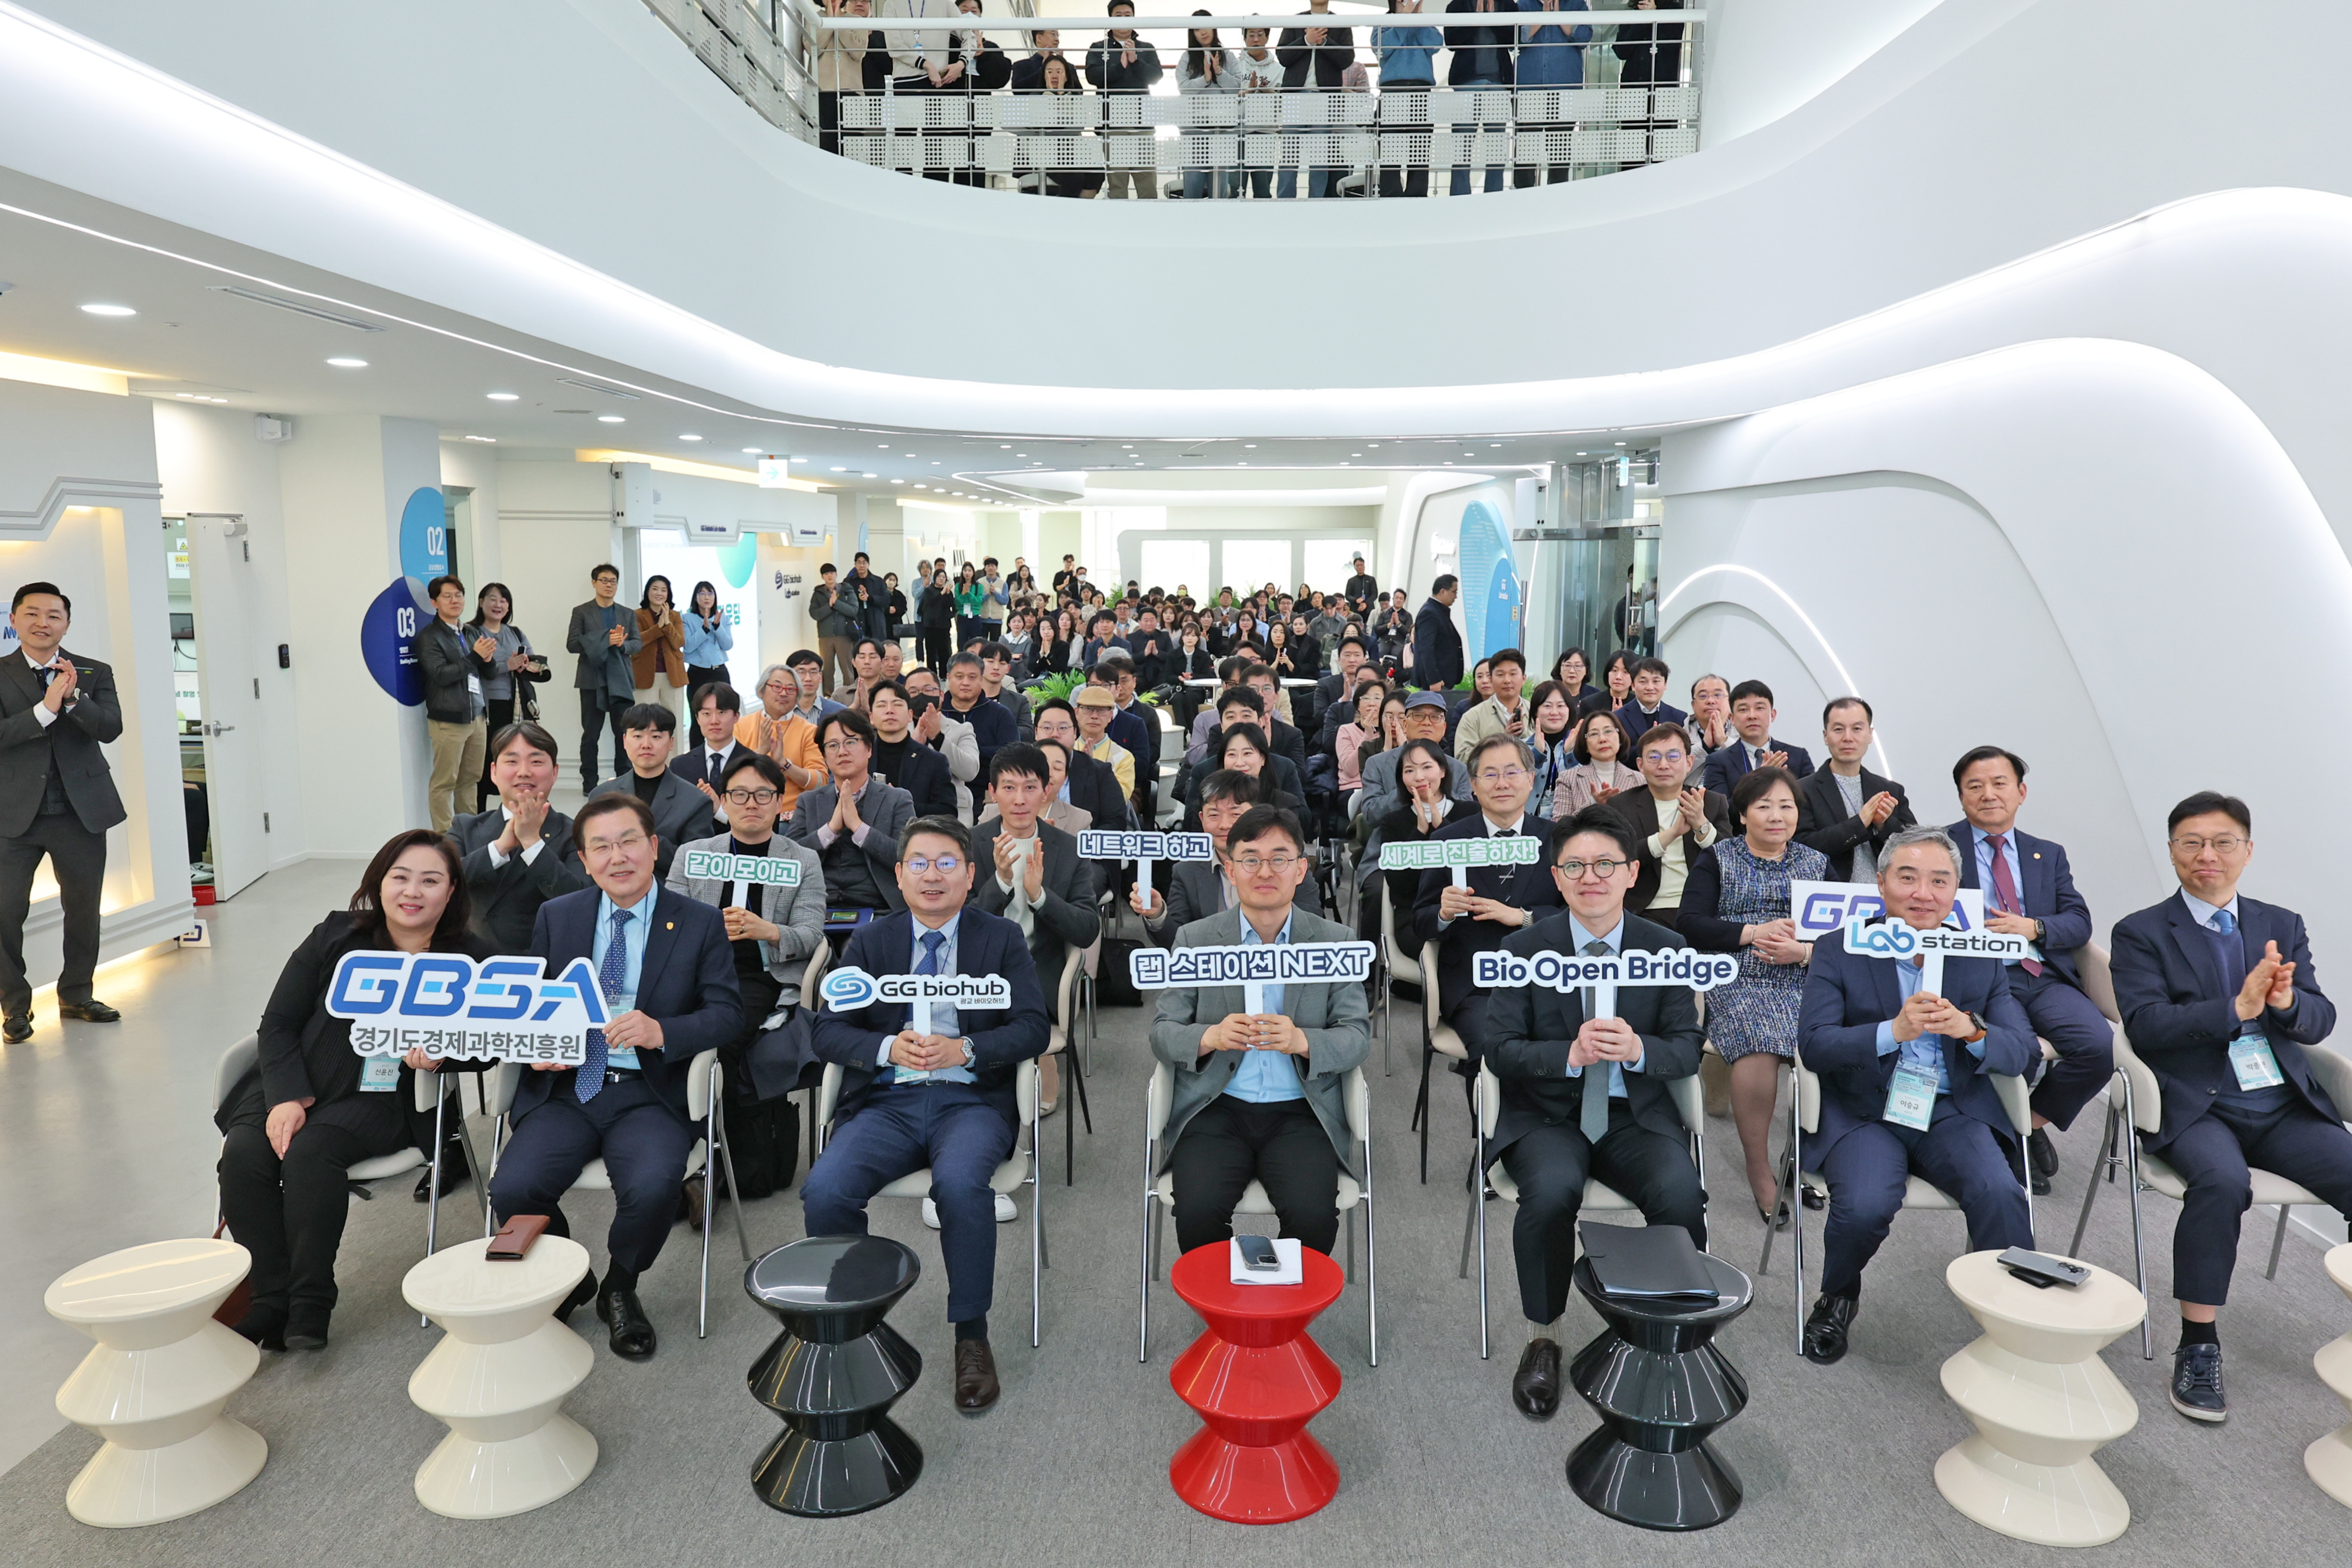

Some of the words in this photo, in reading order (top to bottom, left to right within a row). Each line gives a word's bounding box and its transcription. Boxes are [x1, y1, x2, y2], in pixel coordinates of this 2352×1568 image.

[427, 526, 444, 556] 02
[397, 607, 416, 638] 03
[1080, 833, 1164, 857] 네트워크
[1167, 835, 1211, 858] 하고
[1381, 843, 1445, 867] 세계로
[1446, 839, 1536, 865] 진출하자!
[688, 852, 731, 878] 같이
[734, 857, 798, 884] 모이고
[1801, 893, 1971, 931] GBA
[1851, 922, 1915, 953] Lab
[1922, 934, 2022, 953] station
[1135, 954, 1165, 983] 랩
[1169, 950, 1276, 982] 스테이션
[1280, 947, 1370, 978] NEXT
[1479, 956, 1527, 981] Bio
[1535, 956, 1619, 986] Open
[1628, 954, 1732, 985] Bridge
[331, 956, 606, 1023] GBSA
[880, 981, 917, 997] GG
[924, 981, 1004, 996] biohub
[355, 1027, 580, 1060] 경기도경제과학진흥원
[1900, 1100, 1919, 1110] 이승규
